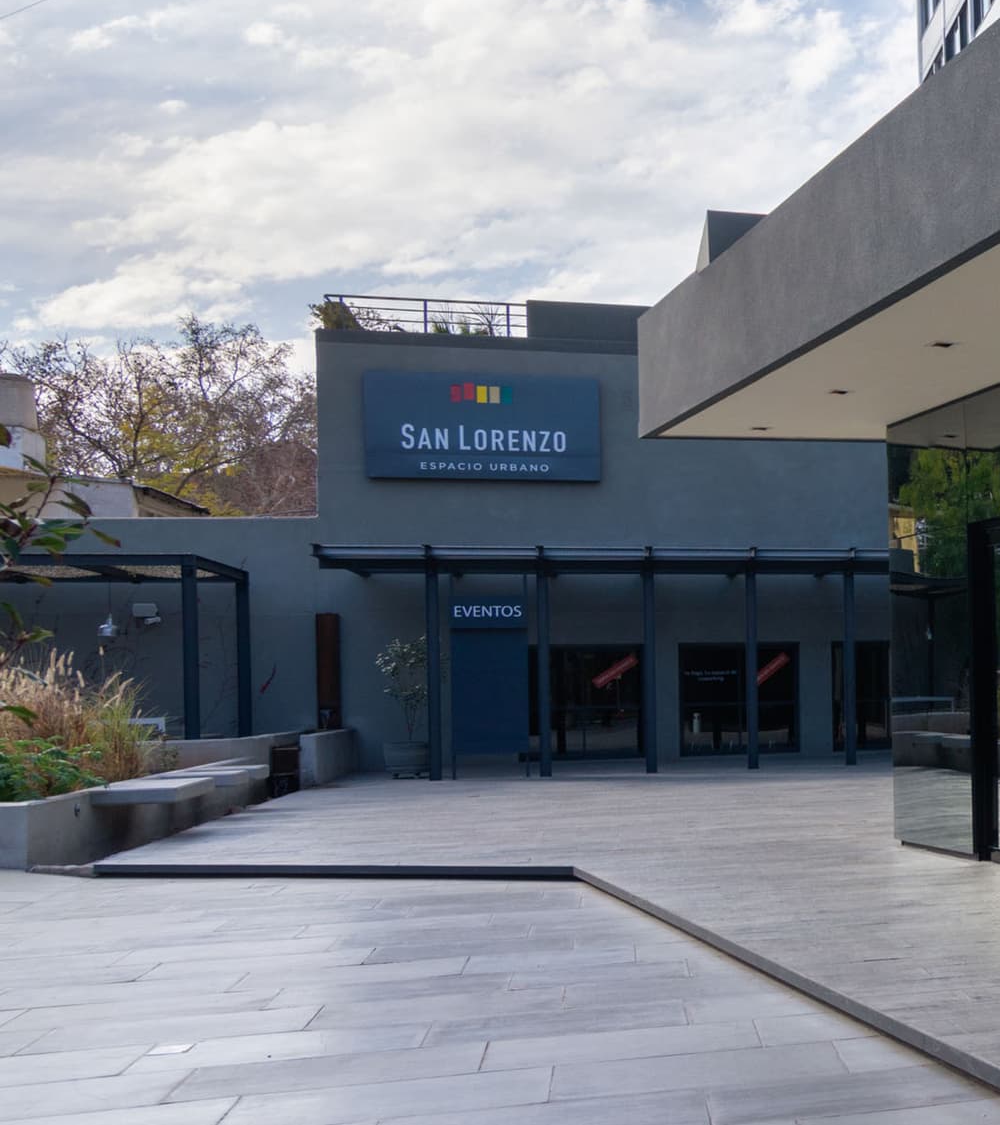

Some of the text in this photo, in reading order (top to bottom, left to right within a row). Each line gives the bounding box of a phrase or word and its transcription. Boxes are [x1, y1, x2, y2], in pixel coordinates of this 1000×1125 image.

[401, 423, 567, 453] SAN LORENZO
[420, 461, 550, 473] ESPACIO URBANO
[453, 605, 522, 618] EVENTOS
